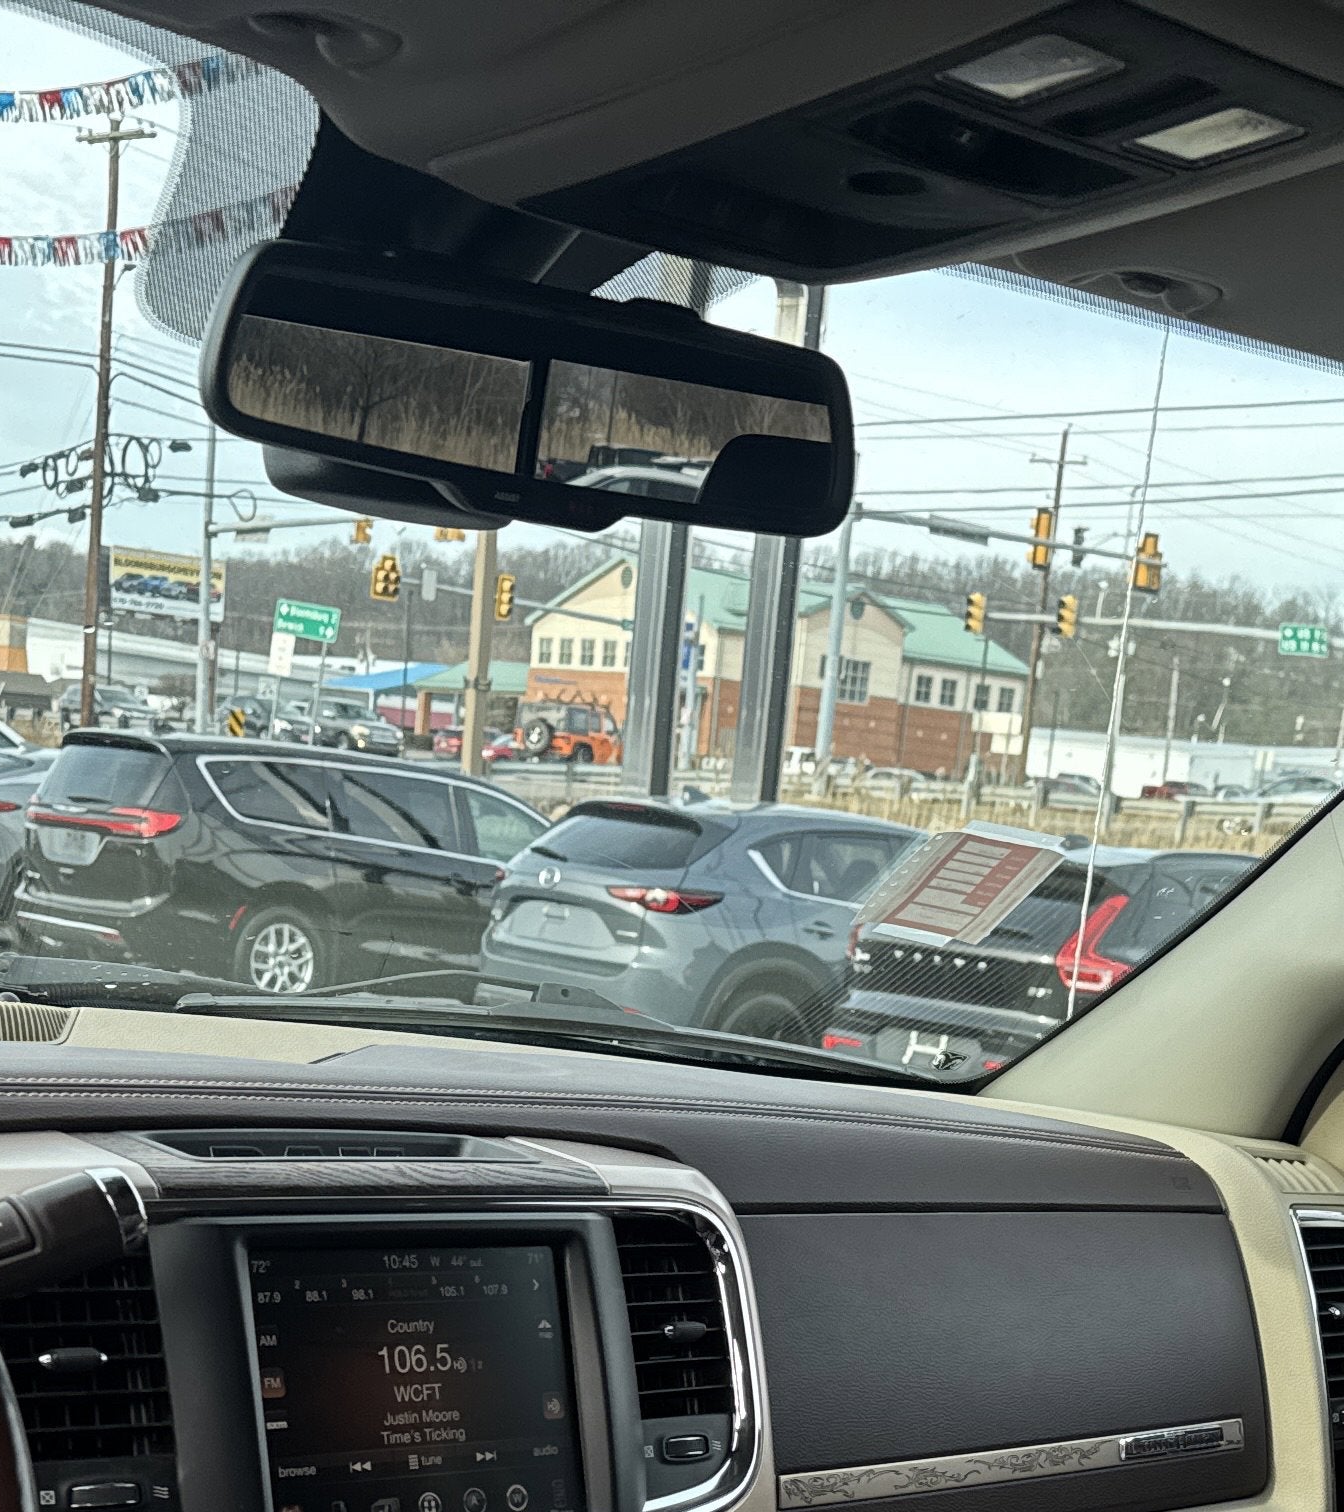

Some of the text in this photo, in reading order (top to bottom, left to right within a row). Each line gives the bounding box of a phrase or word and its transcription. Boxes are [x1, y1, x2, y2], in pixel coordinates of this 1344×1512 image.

[382, 1254, 420, 1270] 10:45
[387, 1318, 436, 1335] Country
[259, 1334, 278, 1347] AM
[377, 1343, 452, 1375] 106.5
[264, 1376, 283, 1390] FM
[393, 1383, 442, 1403] WCFT
[383, 1408, 461, 1427] Justin Moore
[380, 1427, 467, 1446] Time's Ticking
[533, 1444, 559, 1458] audio
[421, 1454, 443, 1467] tune
[277, 1465, 318, 1479] browse
